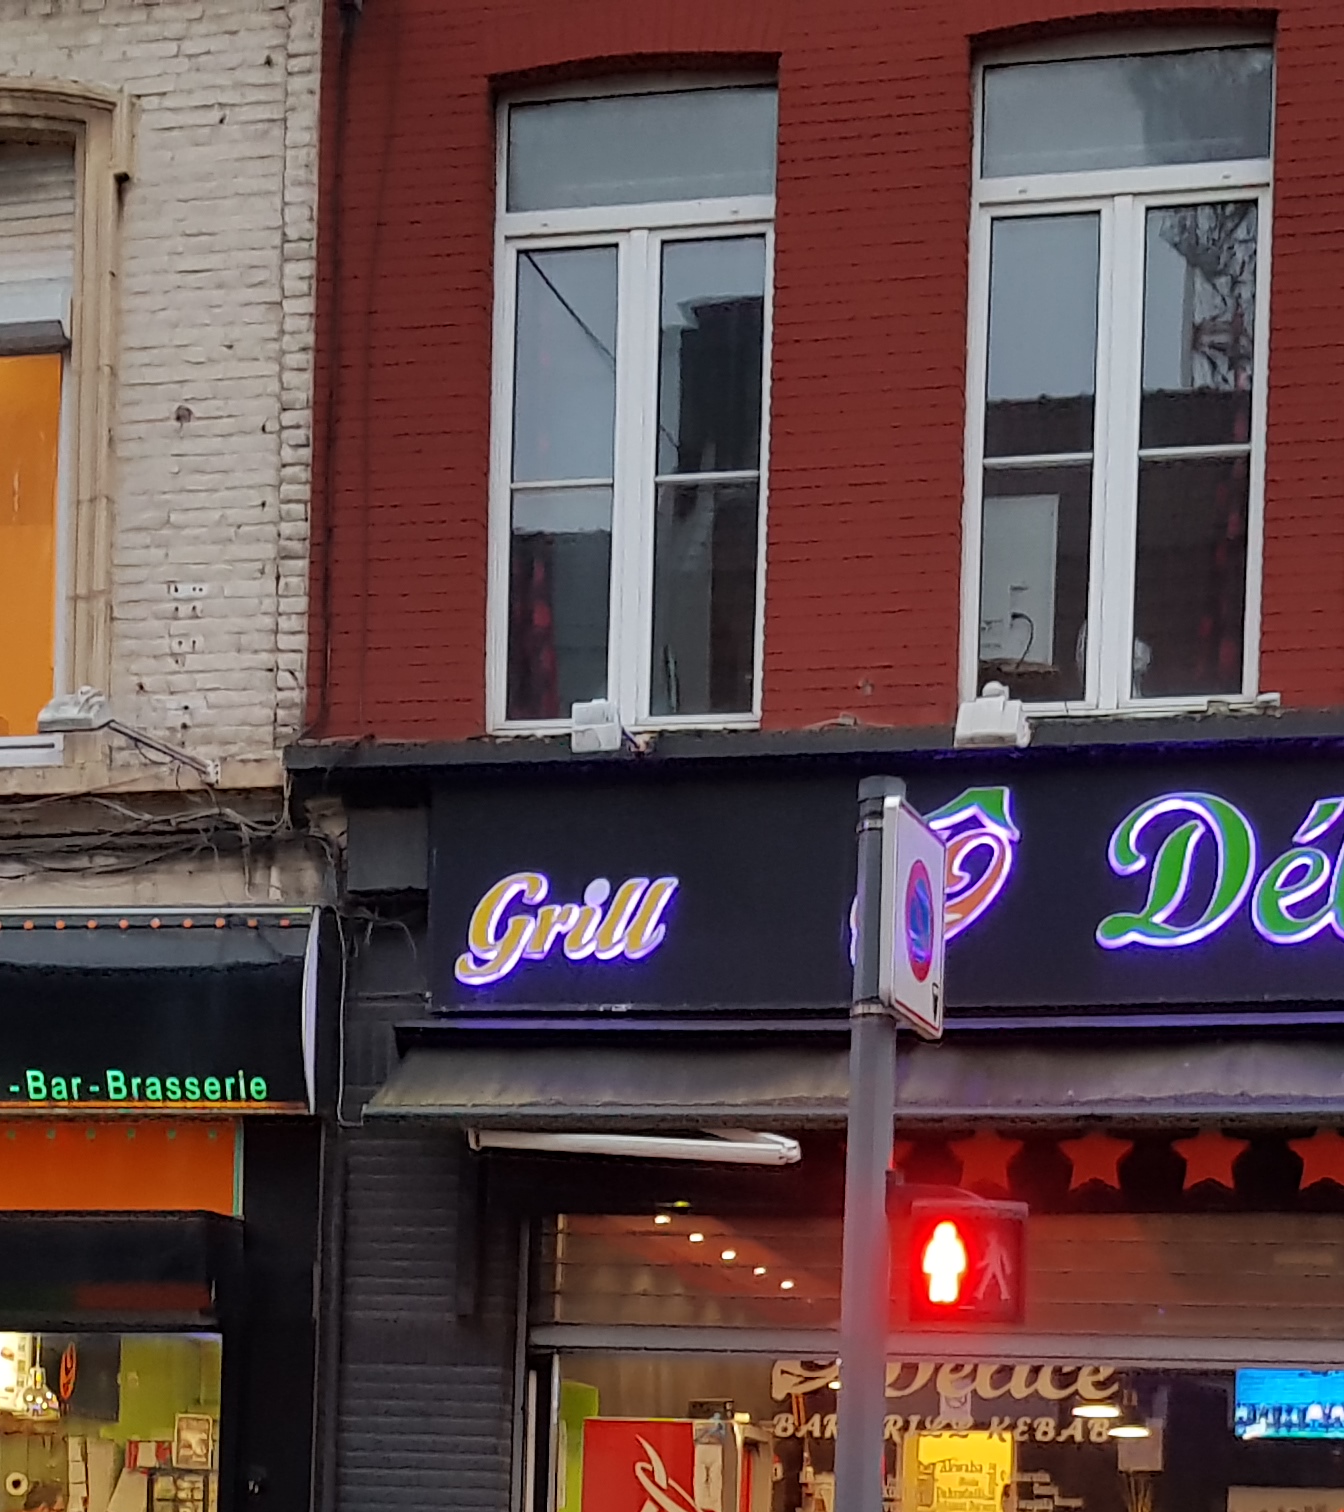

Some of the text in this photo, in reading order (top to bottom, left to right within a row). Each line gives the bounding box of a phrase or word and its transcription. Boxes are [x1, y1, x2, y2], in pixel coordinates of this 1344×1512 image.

[455, 871, 680, 987] Grill
[884, 1415, 973, 1441] RILL
[986, 1416, 1111, 1443] KEBAB
